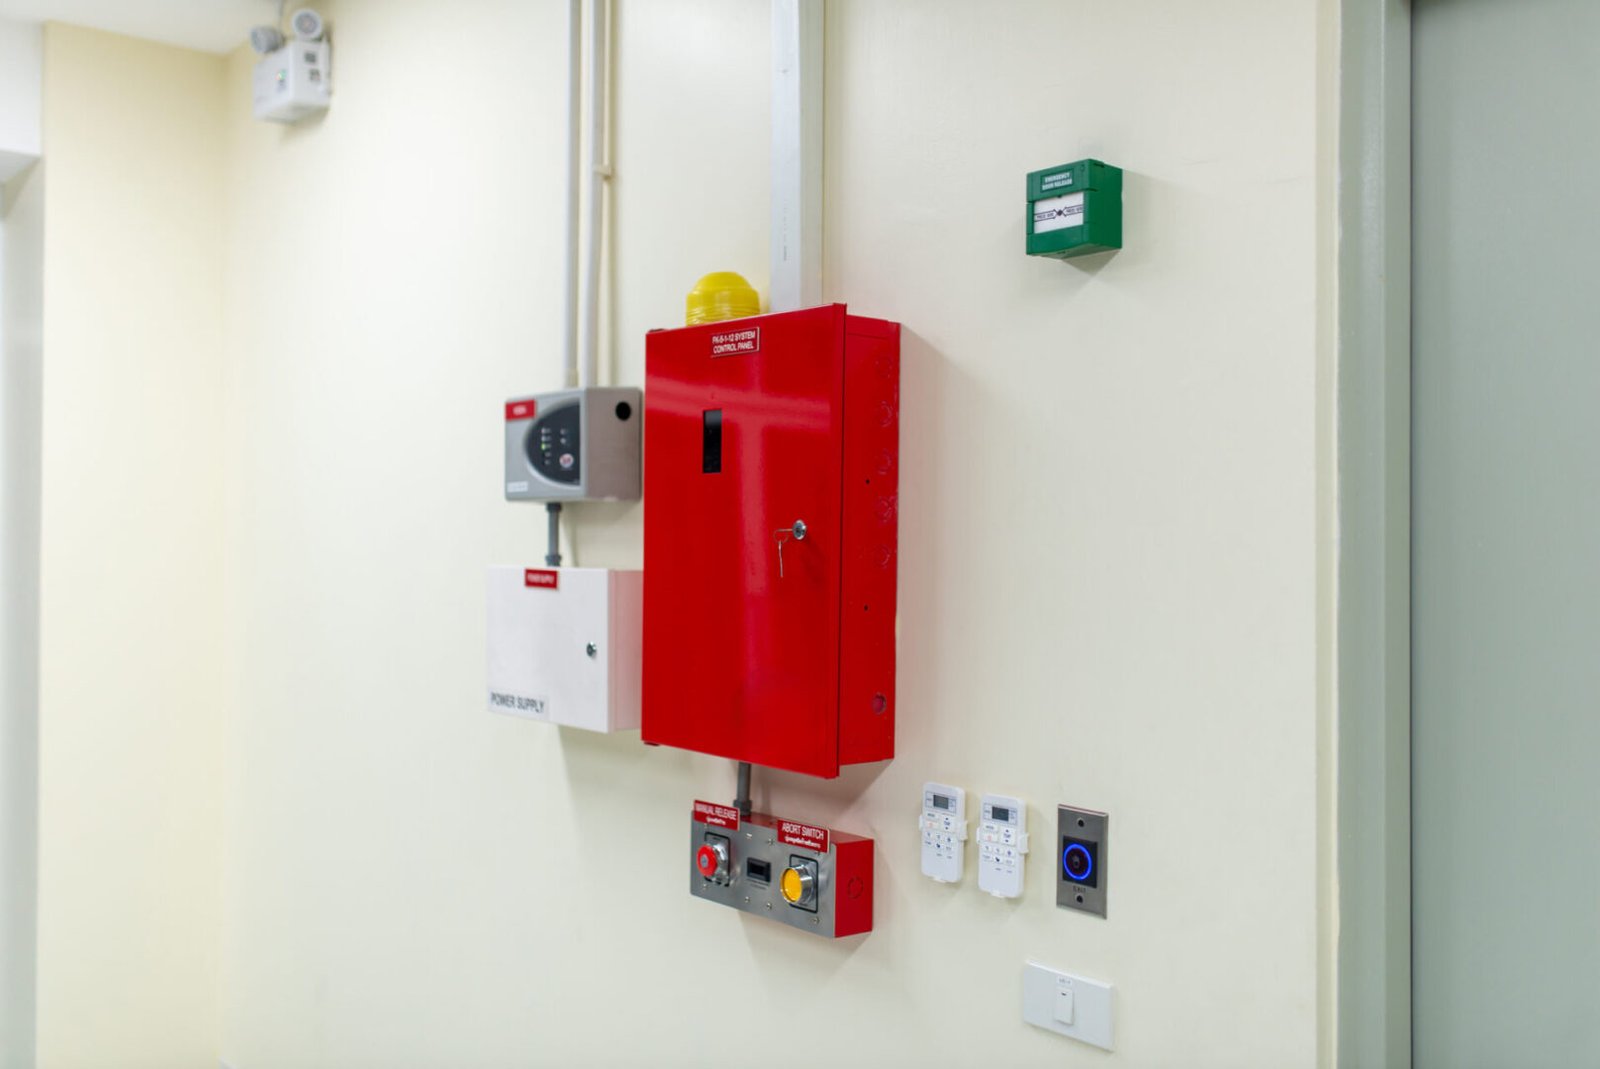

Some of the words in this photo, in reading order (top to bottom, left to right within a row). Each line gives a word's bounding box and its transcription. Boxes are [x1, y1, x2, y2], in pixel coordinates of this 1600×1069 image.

[735, 331, 755, 340] SYSTEM
[714, 344, 737, 353] CONTROL
[738, 341, 754, 350] PANEL
[491, 692, 514, 707] POWER
[517, 696, 544, 713] SUPPLY
[695, 803, 715, 815] MANUAL
[715, 806, 737, 821] RELEASE
[782, 822, 801, 835] ABORT
[801, 826, 824, 840] SWITCH
